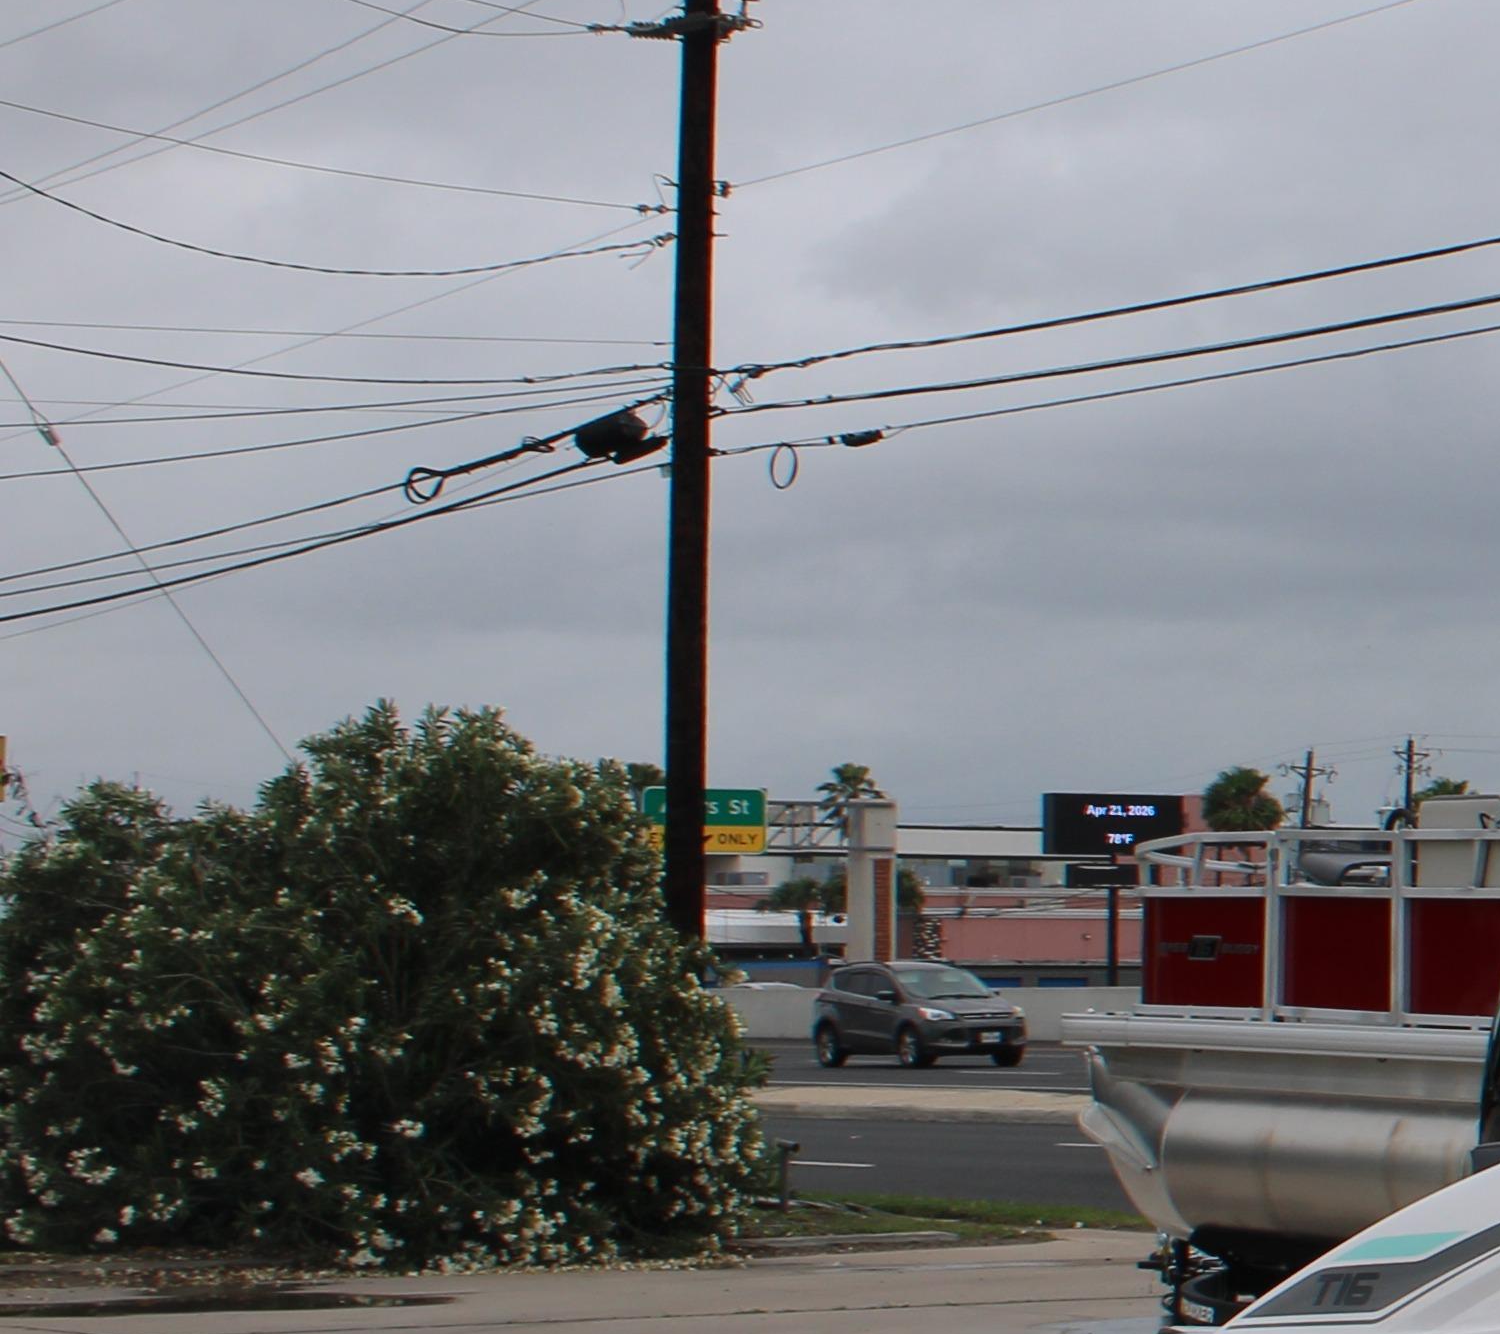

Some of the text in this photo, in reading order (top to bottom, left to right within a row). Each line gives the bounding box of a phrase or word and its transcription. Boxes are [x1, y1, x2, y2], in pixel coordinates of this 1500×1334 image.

[728, 799, 750, 816] St
[1085, 805, 1156, 818] Apr 21, 2026
[718, 833, 758, 846] ONLY
[1312, 1271, 1381, 1307] T16
